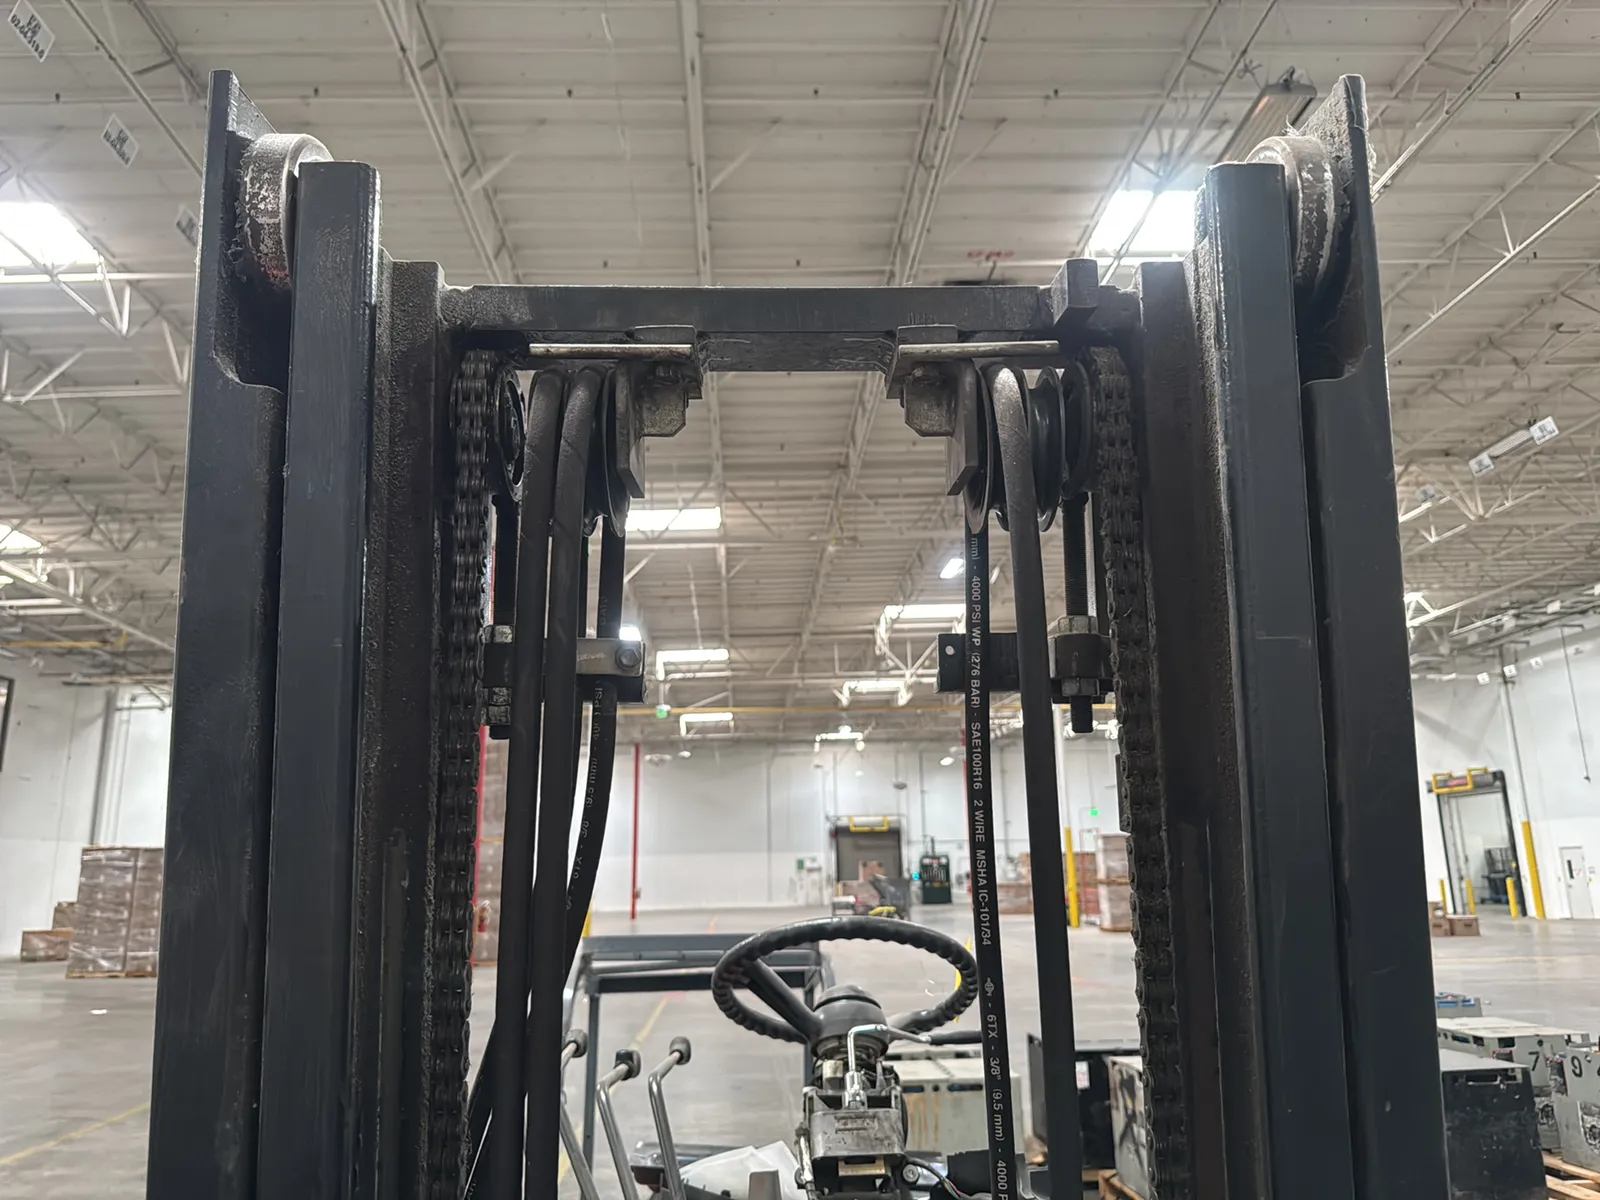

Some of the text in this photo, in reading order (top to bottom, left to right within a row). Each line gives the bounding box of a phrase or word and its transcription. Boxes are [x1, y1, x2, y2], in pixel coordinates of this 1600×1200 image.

[971, 537, 981, 560] mm)
[971, 575, 981, 601] 4000
[971, 604, 981, 623] PSI
[971, 626, 981, 646] WP
[971, 652, 981, 676] (276
[594, 687, 603, 708] PSI
[970, 679, 981, 708] BAR)
[971, 722, 983, 790] SAE100R16
[973, 799, 984, 807] 2
[974, 810, 985, 843] WIRE
[976, 850, 987, 887] MSHA
[978, 890, 991, 946] IC-101/34
[986, 1015, 998, 1038] 6TX
[1528, 1051, 1539, 1071] 7
[992, 1089, 1003, 1111] (9.5
[994, 1114, 1005, 1141] mm)
[997, 1160, 1008, 1190] 4000
